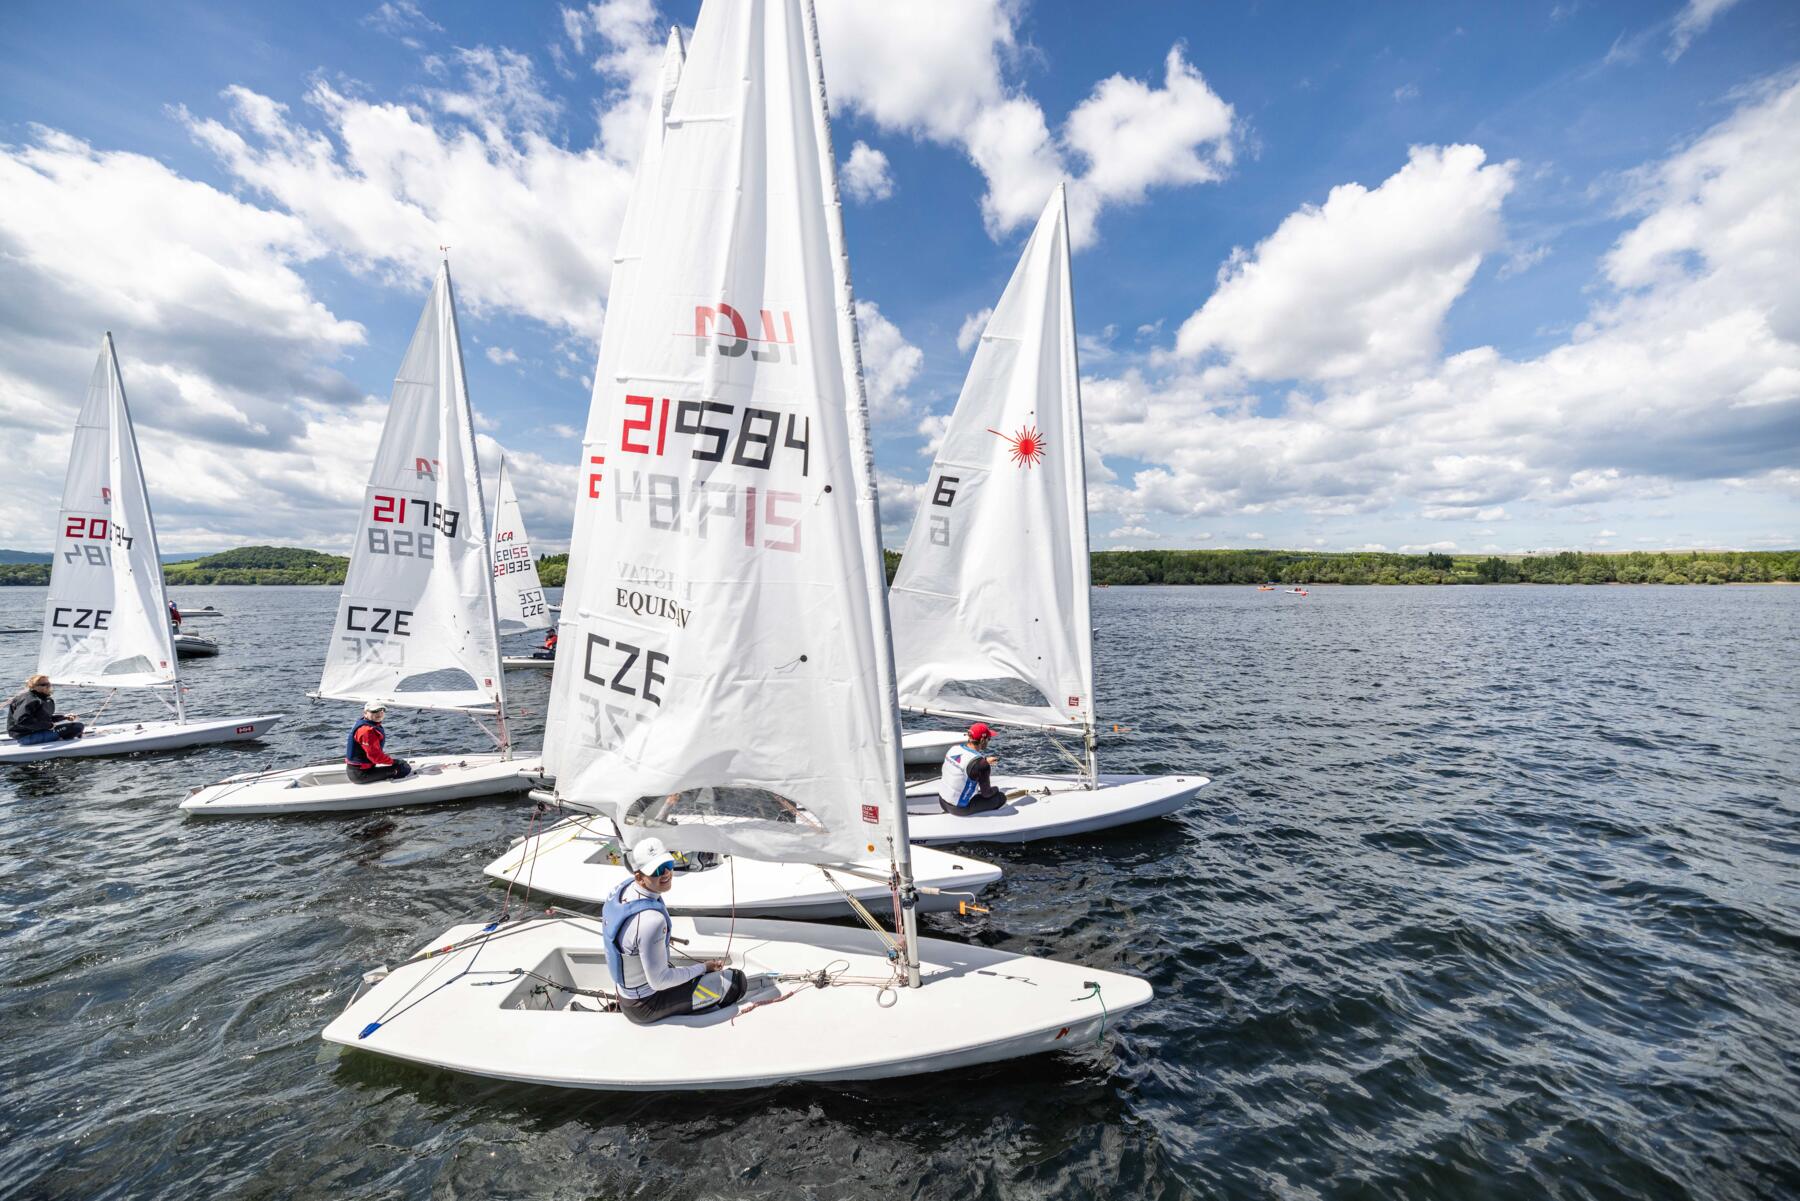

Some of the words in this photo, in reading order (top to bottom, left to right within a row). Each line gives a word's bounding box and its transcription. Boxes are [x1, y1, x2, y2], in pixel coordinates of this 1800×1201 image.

[932, 475, 960, 508] 6
[52, 608, 112, 630] CZE
[347, 605, 414, 636] CZE
[522, 603, 545, 618] CZE
[584, 632, 670, 707] CZE
